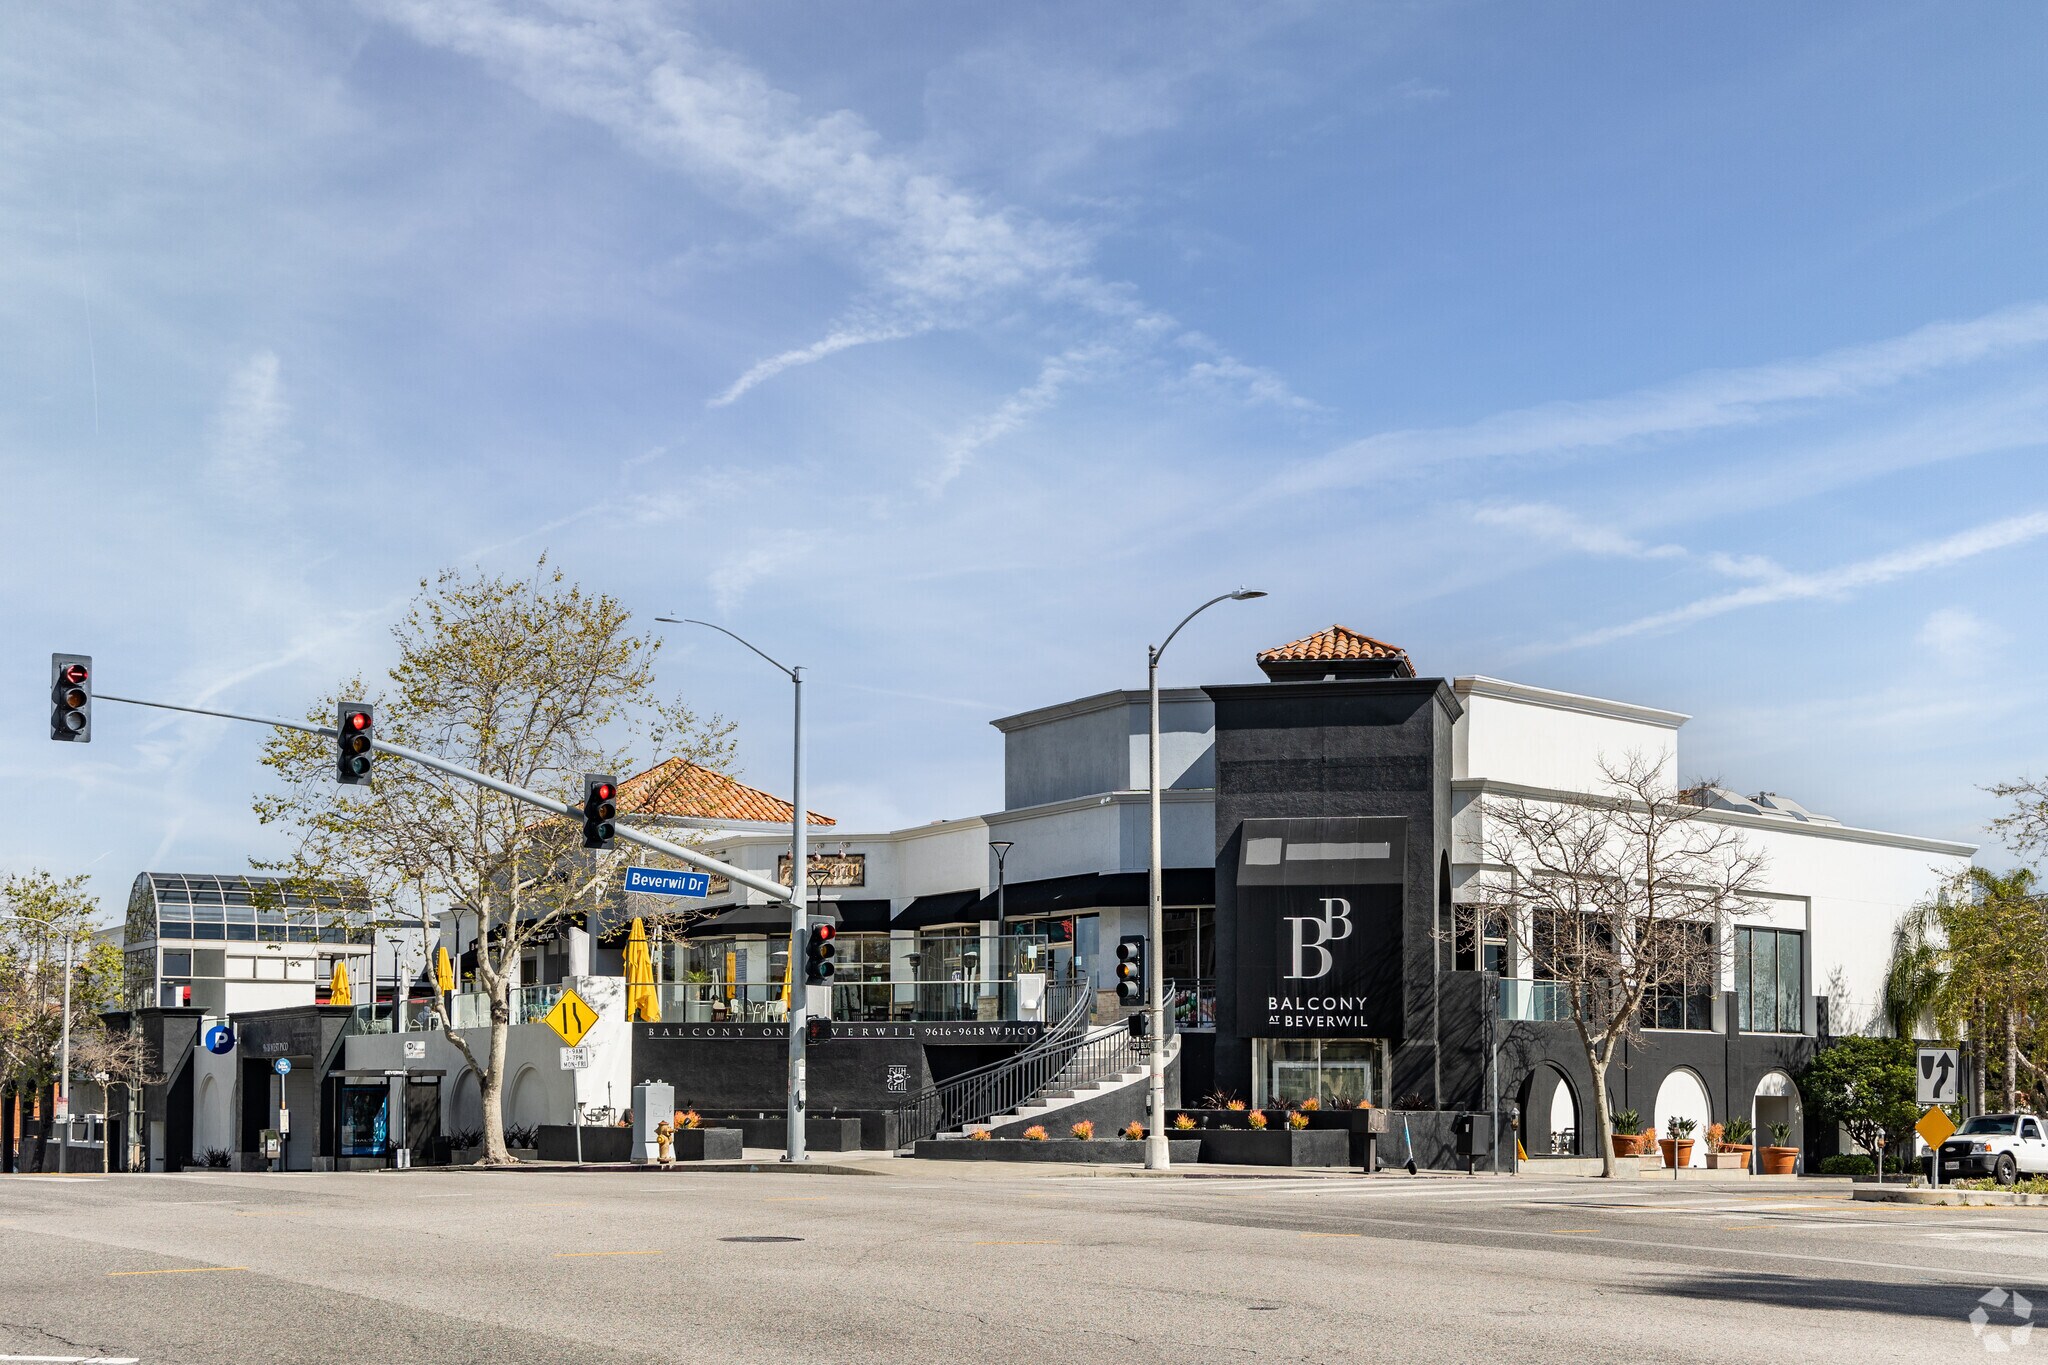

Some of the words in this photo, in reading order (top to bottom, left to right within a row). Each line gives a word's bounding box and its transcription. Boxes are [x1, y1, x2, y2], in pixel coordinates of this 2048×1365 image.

[632, 872, 686, 890] Beverwil
[688, 877, 704, 891] Dr
[1268, 997, 1367, 1010] BALCONY
[1269, 1015, 1279, 1024] AT
[1285, 1016, 1368, 1027] BEVERWIL
[648, 1028, 745, 1037] BALCONY
[763, 1028, 784, 1037] ON
[831, 1027, 915, 1037] VERWIL
[925, 1027, 985, 1037] 9616-9618
[1004, 1027, 1037, 1037] PICO
[215, 1032, 228, 1048] P
